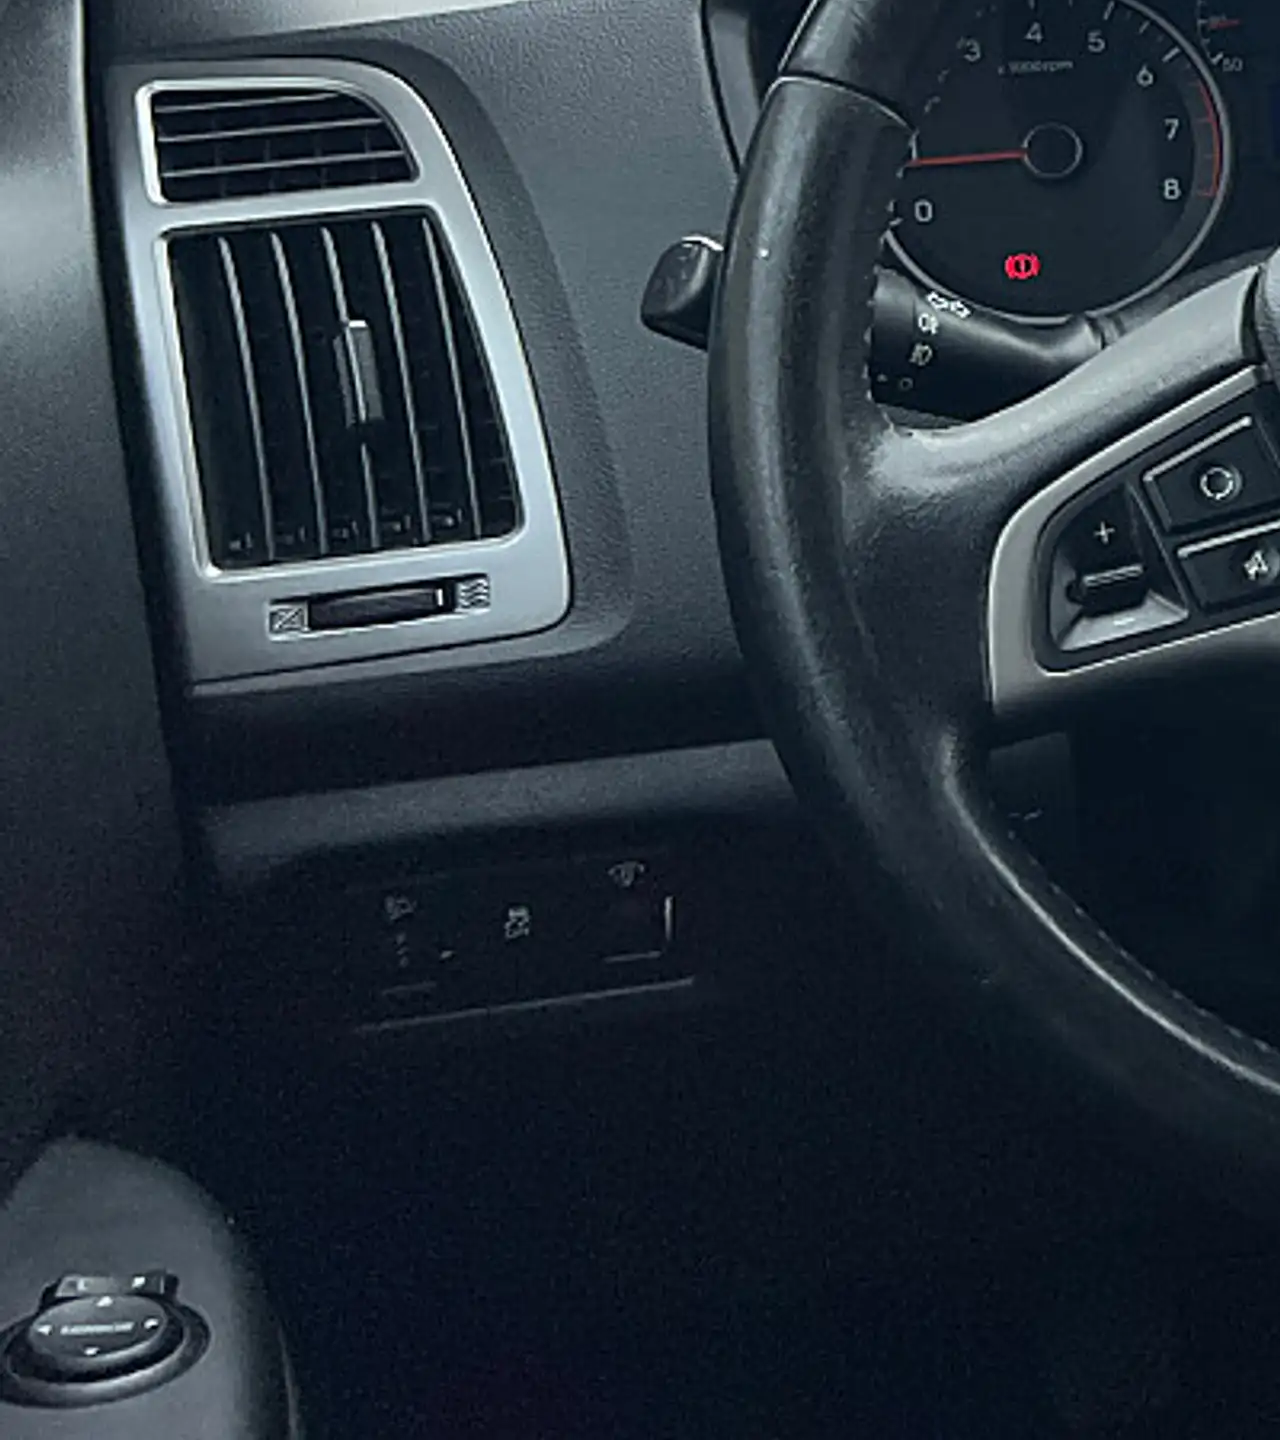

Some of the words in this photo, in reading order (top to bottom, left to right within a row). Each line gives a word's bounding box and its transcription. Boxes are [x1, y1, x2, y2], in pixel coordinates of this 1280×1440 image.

[1023, 21, 1044, 44] 4
[1087, 32, 1106, 53] 5
[964, 40, 982, 62] 3
[1136, 66, 1154, 87] 6
[1164, 118, 1180, 141] 7
[1164, 179, 1182, 200] 8
[914, 200, 933, 223] 0
